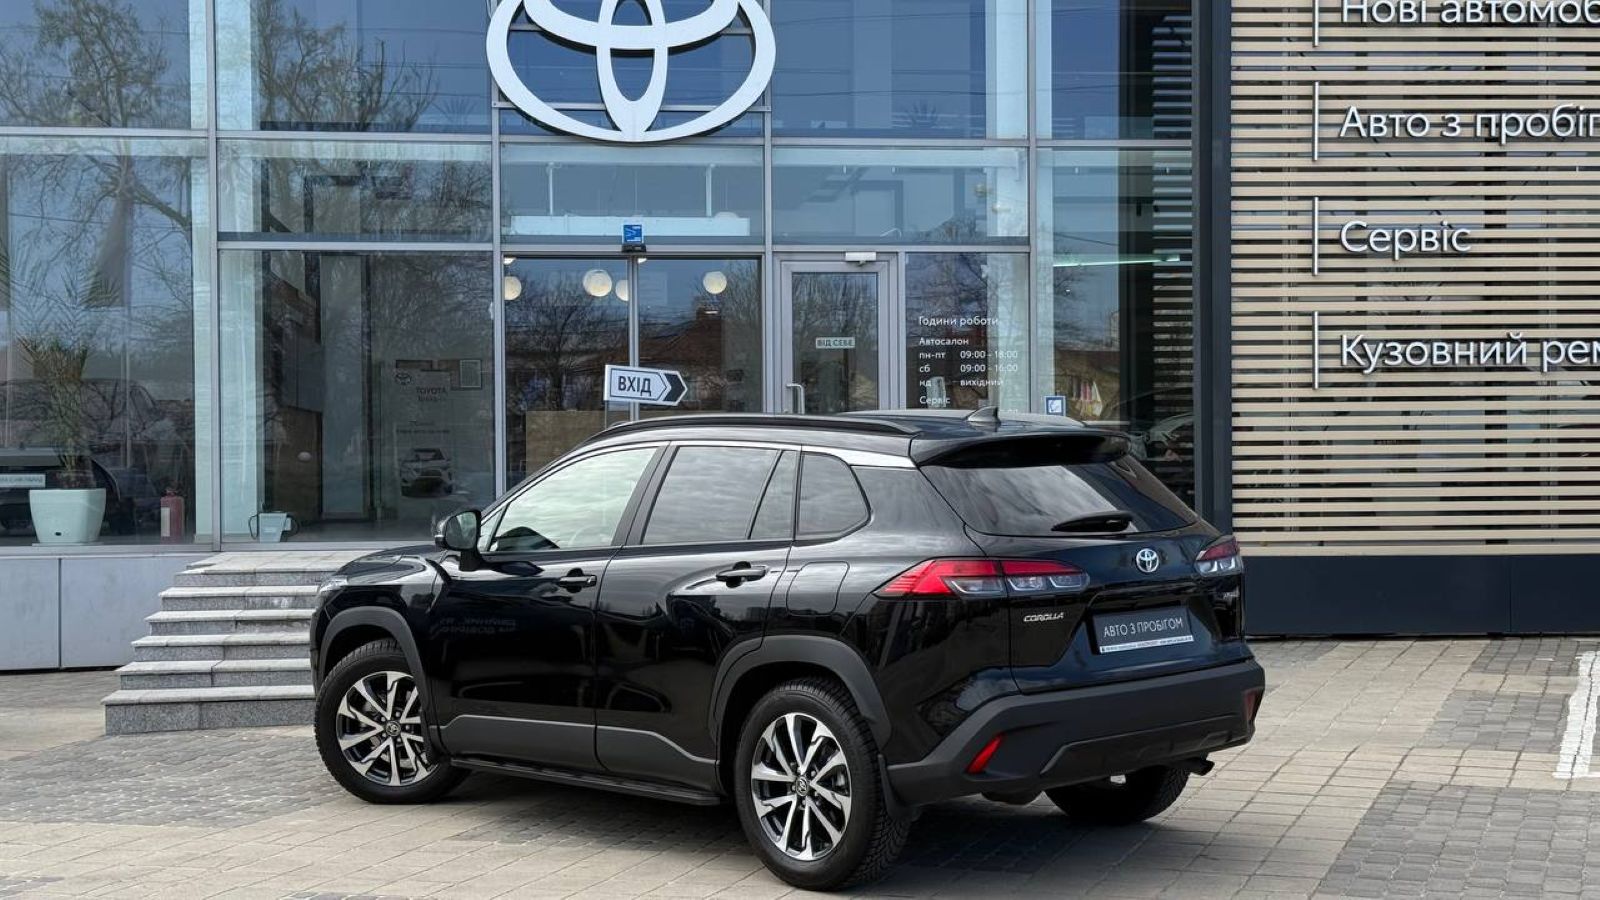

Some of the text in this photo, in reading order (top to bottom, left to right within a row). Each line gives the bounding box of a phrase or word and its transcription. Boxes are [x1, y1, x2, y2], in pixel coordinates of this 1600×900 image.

[1340, 106, 1430, 138] Авто
[1441, 113, 1461, 138] з
[1340, 220, 1472, 260] Сервіс
[918, 315, 999, 327] Години роботи
[918, 337, 969, 346] Автосалон
[960, 350, 986, 359] 09:00
[1341, 331, 1527, 374] Кузовний
[919, 364, 931, 373] сб
[960, 364, 986, 373] 09:00
[416, 387, 447, 395] TOYOTA
[617, 375, 653, 396] ВХІД
[1023, 611, 1065, 623] COROLLA
[1103, 624, 1128, 638] АВТО
[1136, 617, 1184, 633] ПРОБІГОМ
